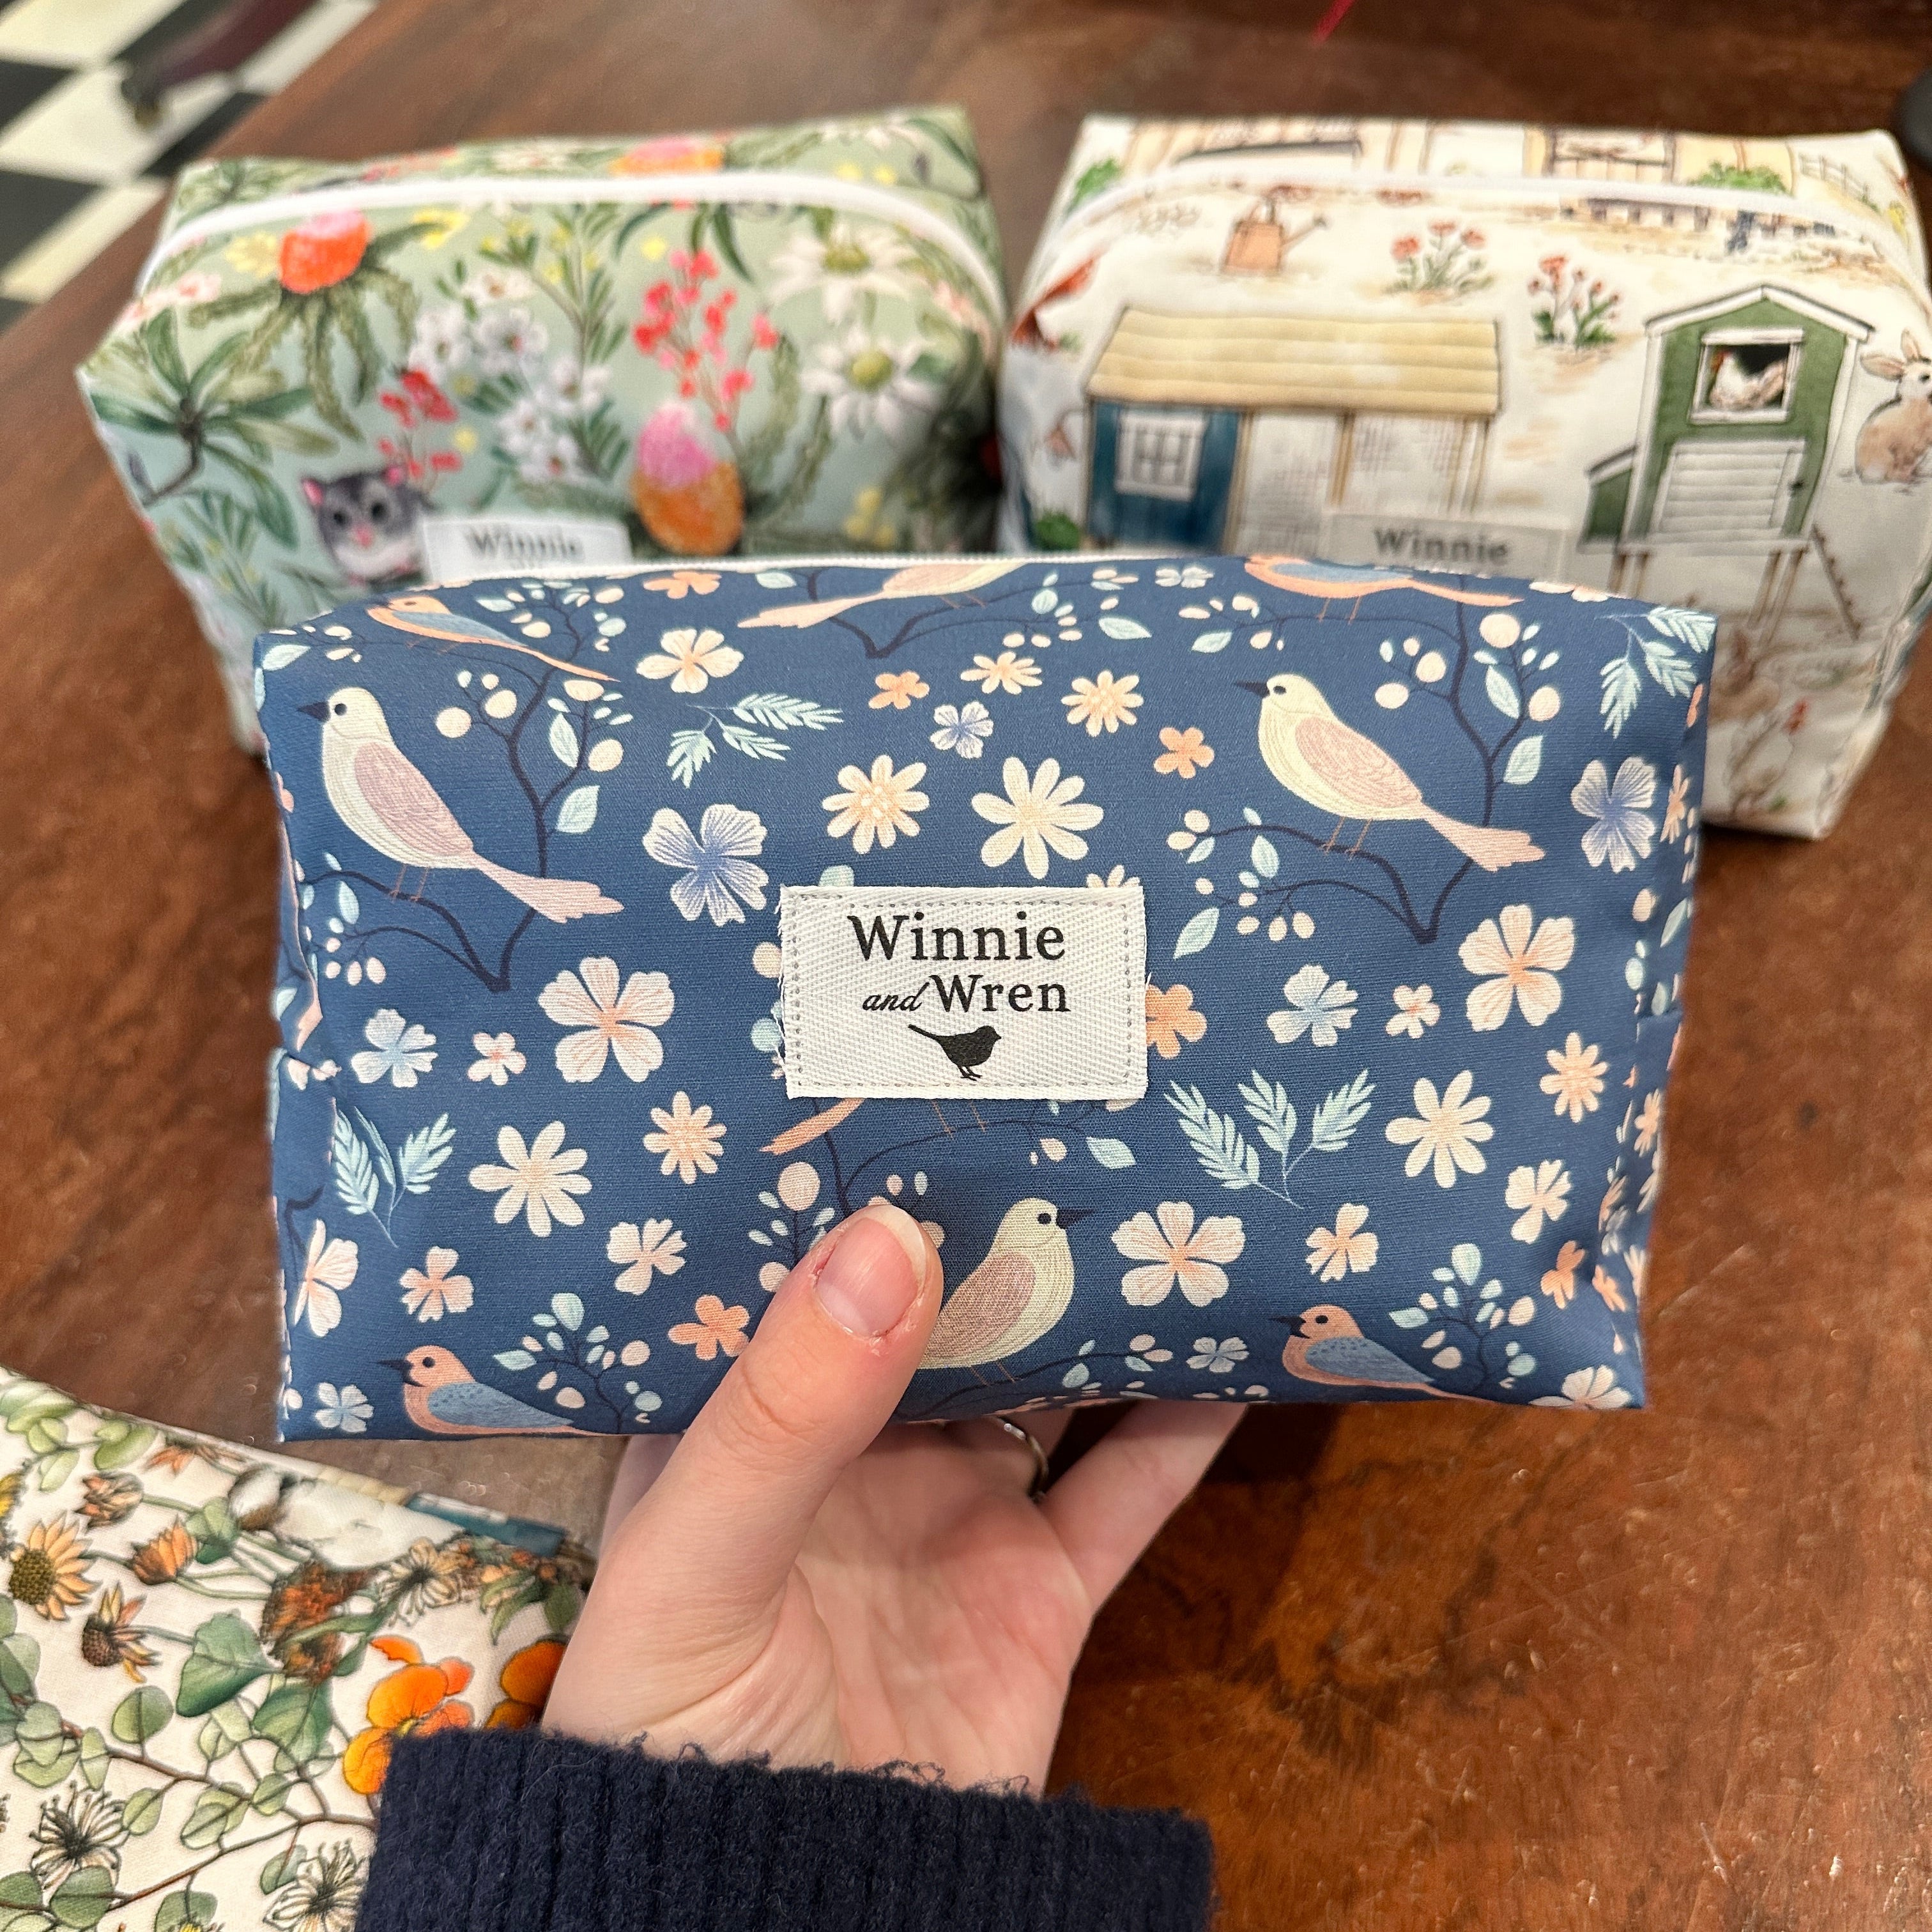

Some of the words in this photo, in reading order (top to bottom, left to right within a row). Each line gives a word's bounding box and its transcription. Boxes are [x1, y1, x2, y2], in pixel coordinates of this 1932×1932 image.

[465, 524, 585, 562] Winnie
[1374, 526, 1508, 564] Winnie
[847, 911, 1065, 961] Winnie
[862, 982, 930, 1011] and
[929, 974, 1071, 1013] Wren
